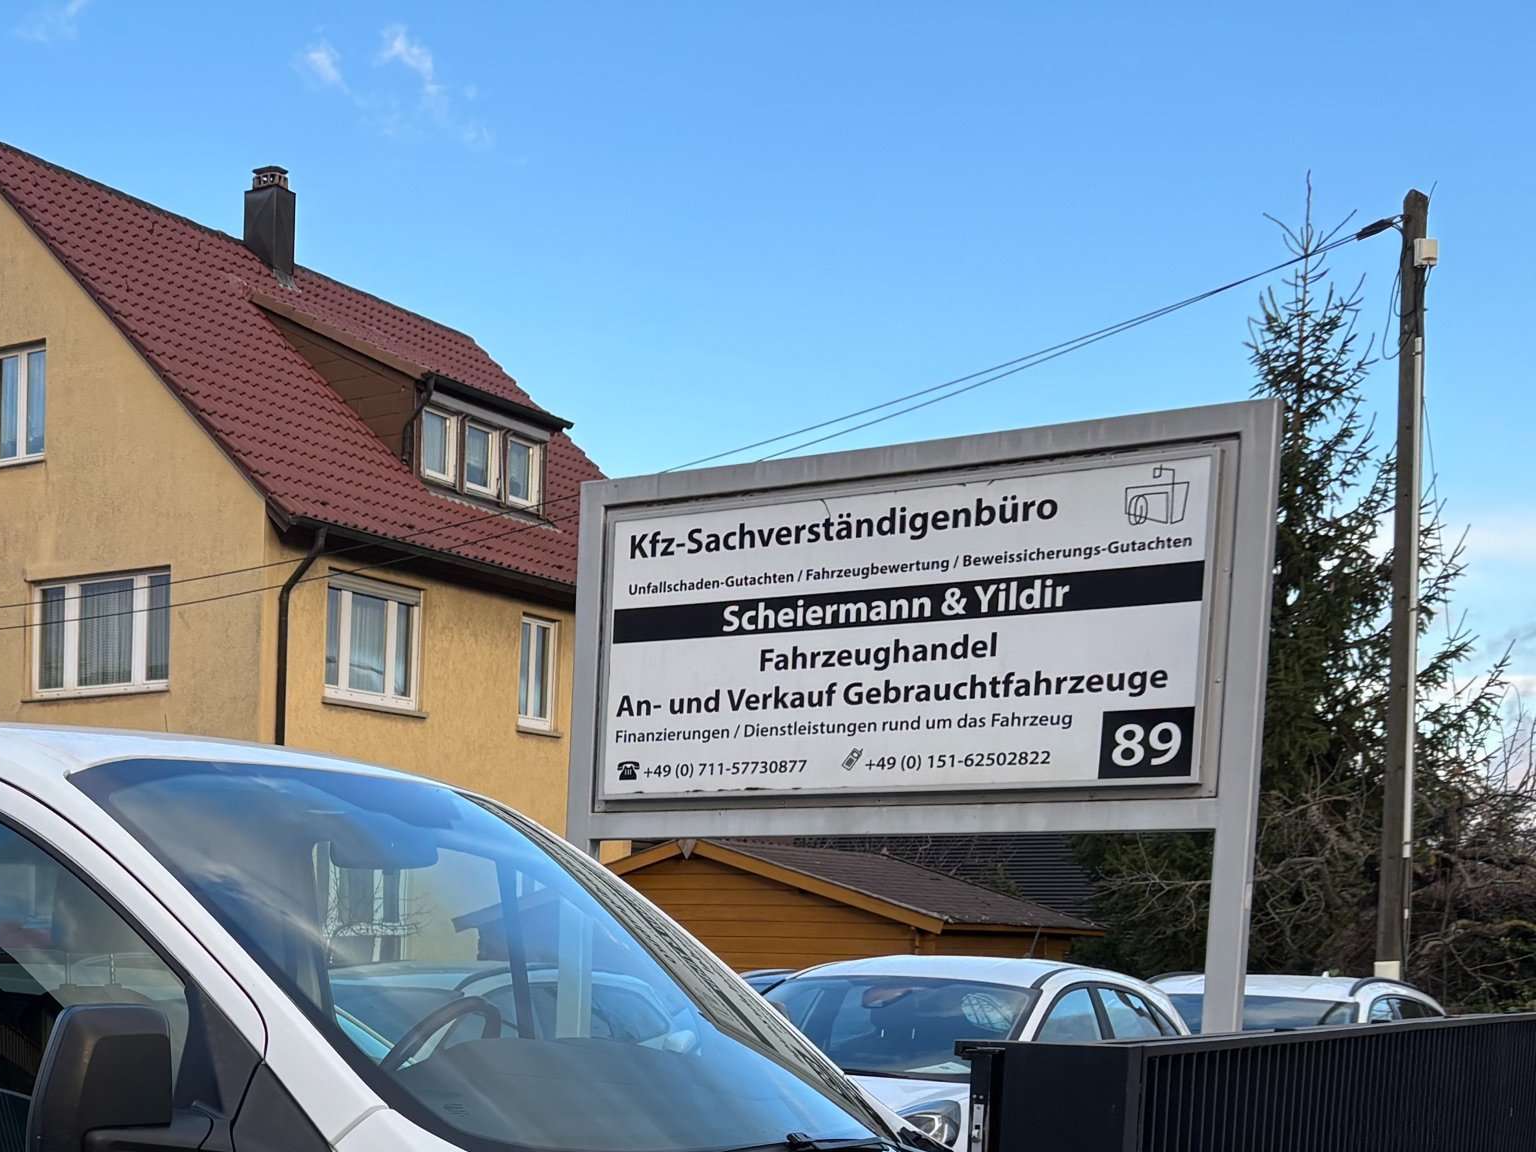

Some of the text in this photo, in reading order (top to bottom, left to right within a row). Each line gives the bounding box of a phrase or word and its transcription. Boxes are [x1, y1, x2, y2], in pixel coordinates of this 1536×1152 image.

[629, 495, 1058, 560] Kfz-Sachverständigenbüro
[628, 535, 1193, 596] Unfallschaden-Gutachten / Fahrzeugbewertung / Beweissicherungs-Gutachten
[722, 579, 1070, 632] Scheiermann & Yildir
[760, 632, 998, 671] Fahrzeughandel
[616, 669, 1168, 718] An- und Verkauf Gebrauchtfahrzeuge
[615, 712, 1073, 744] Finanzierungen / Dienstleistungen rund um das Fahrzeug
[1111, 721, 1183, 768] 89
[643, 759, 808, 779] +49 (0) 711-57730877
[865, 750, 1051, 772] +49 (0) 151-62502822
